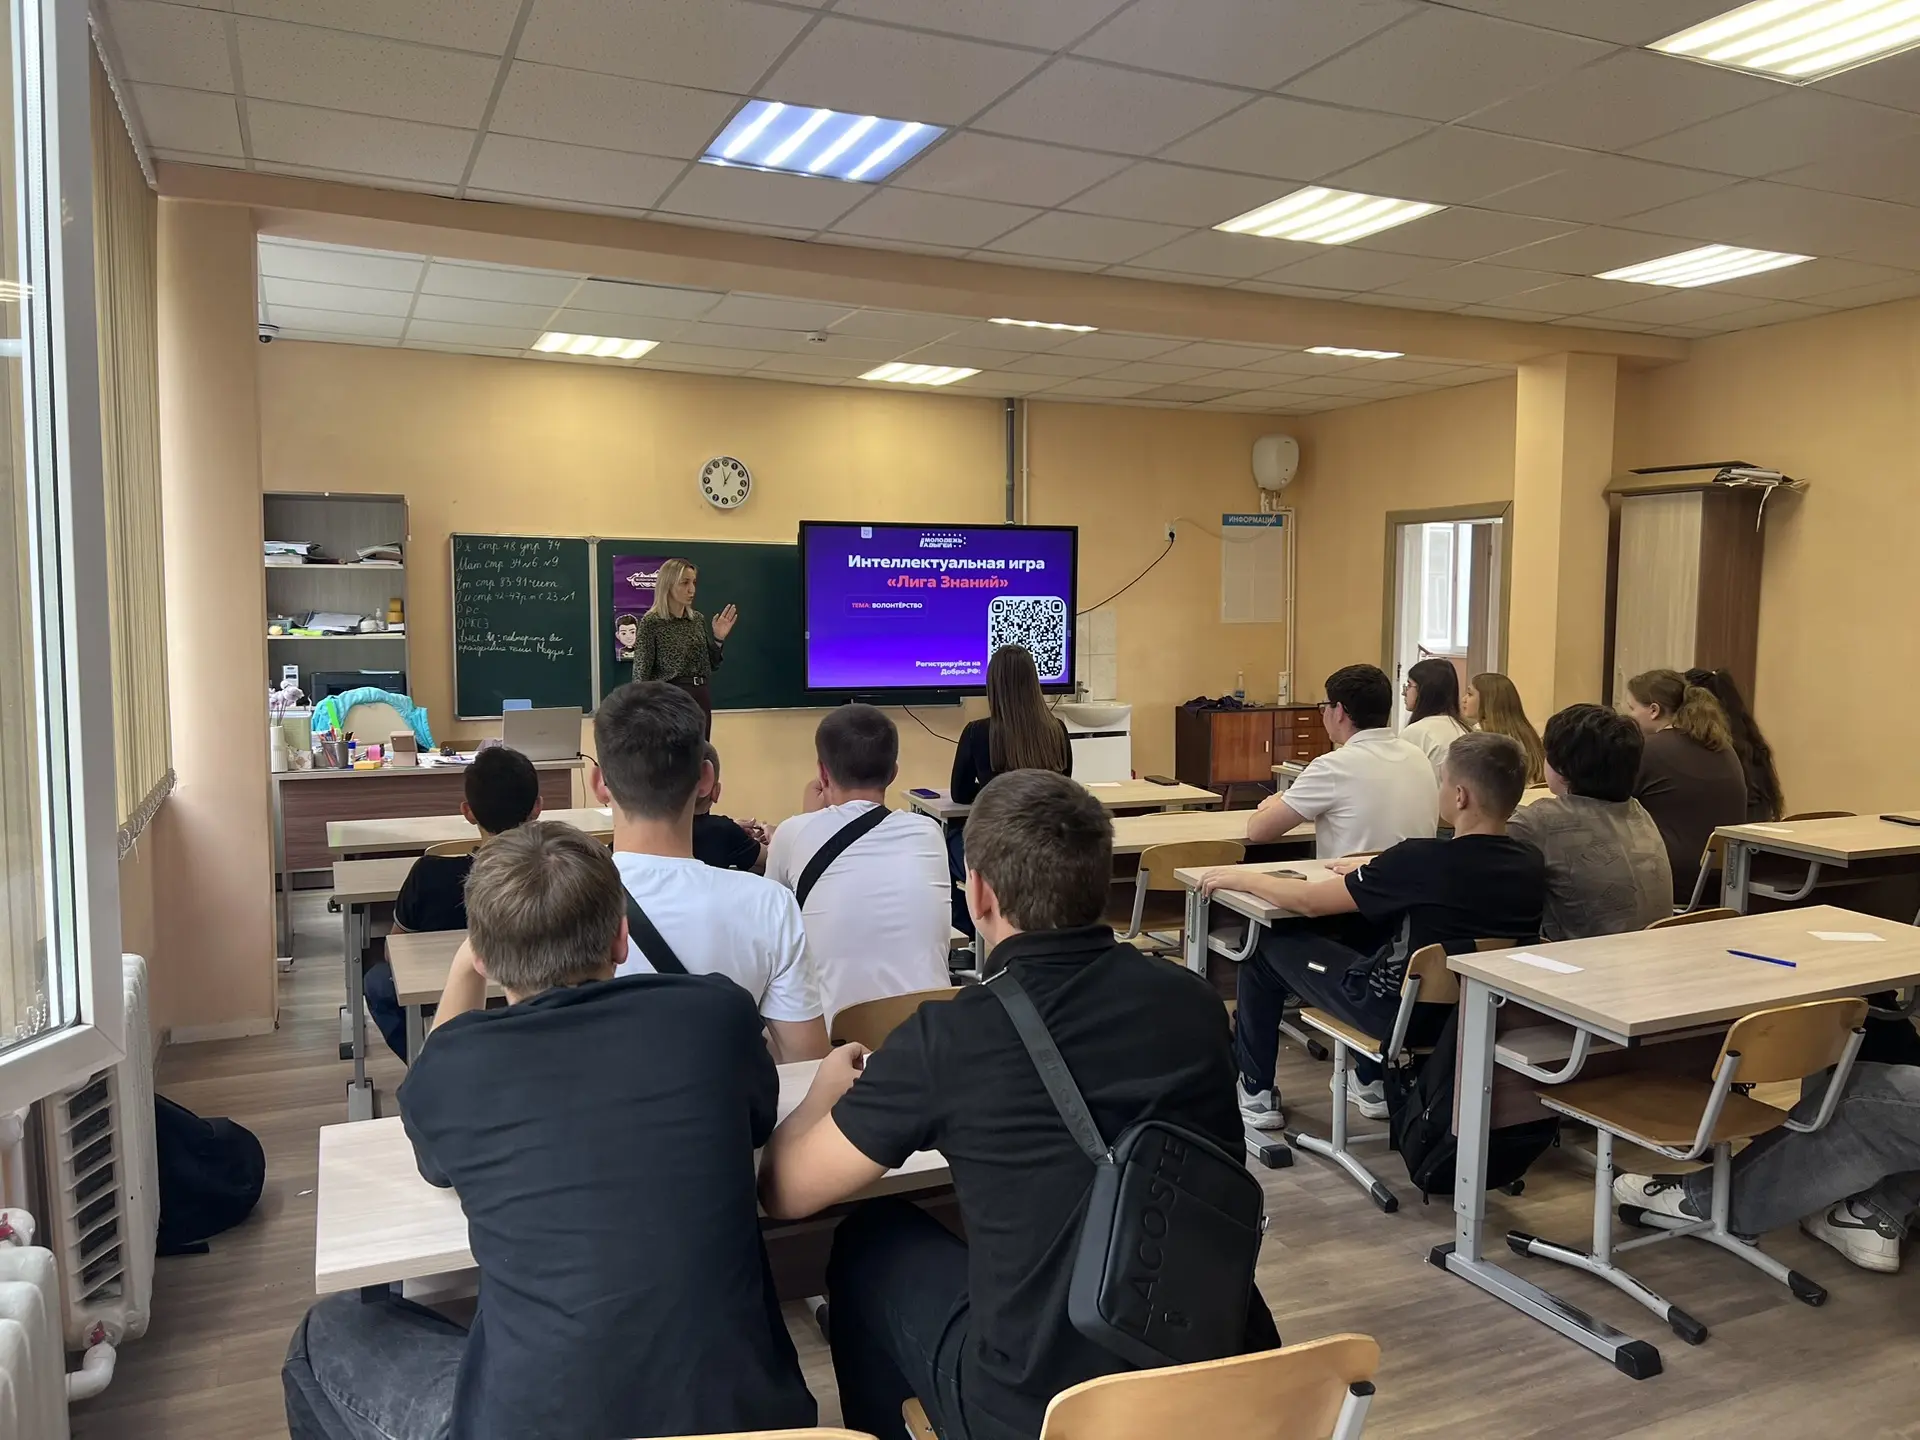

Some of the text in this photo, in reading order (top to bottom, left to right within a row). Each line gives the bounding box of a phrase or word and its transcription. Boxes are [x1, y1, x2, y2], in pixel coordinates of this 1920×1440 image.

[1228, 516, 1277, 524] ИНФОРМАЦИЯ
[848, 554, 1045, 572] Интеллектуальная игра
[887, 575, 1009, 588] «Лига Знаний»
[871, 601, 923, 609] ВОЛОНТЁРСТВО
[915, 660, 971, 668] Регистрируйся
